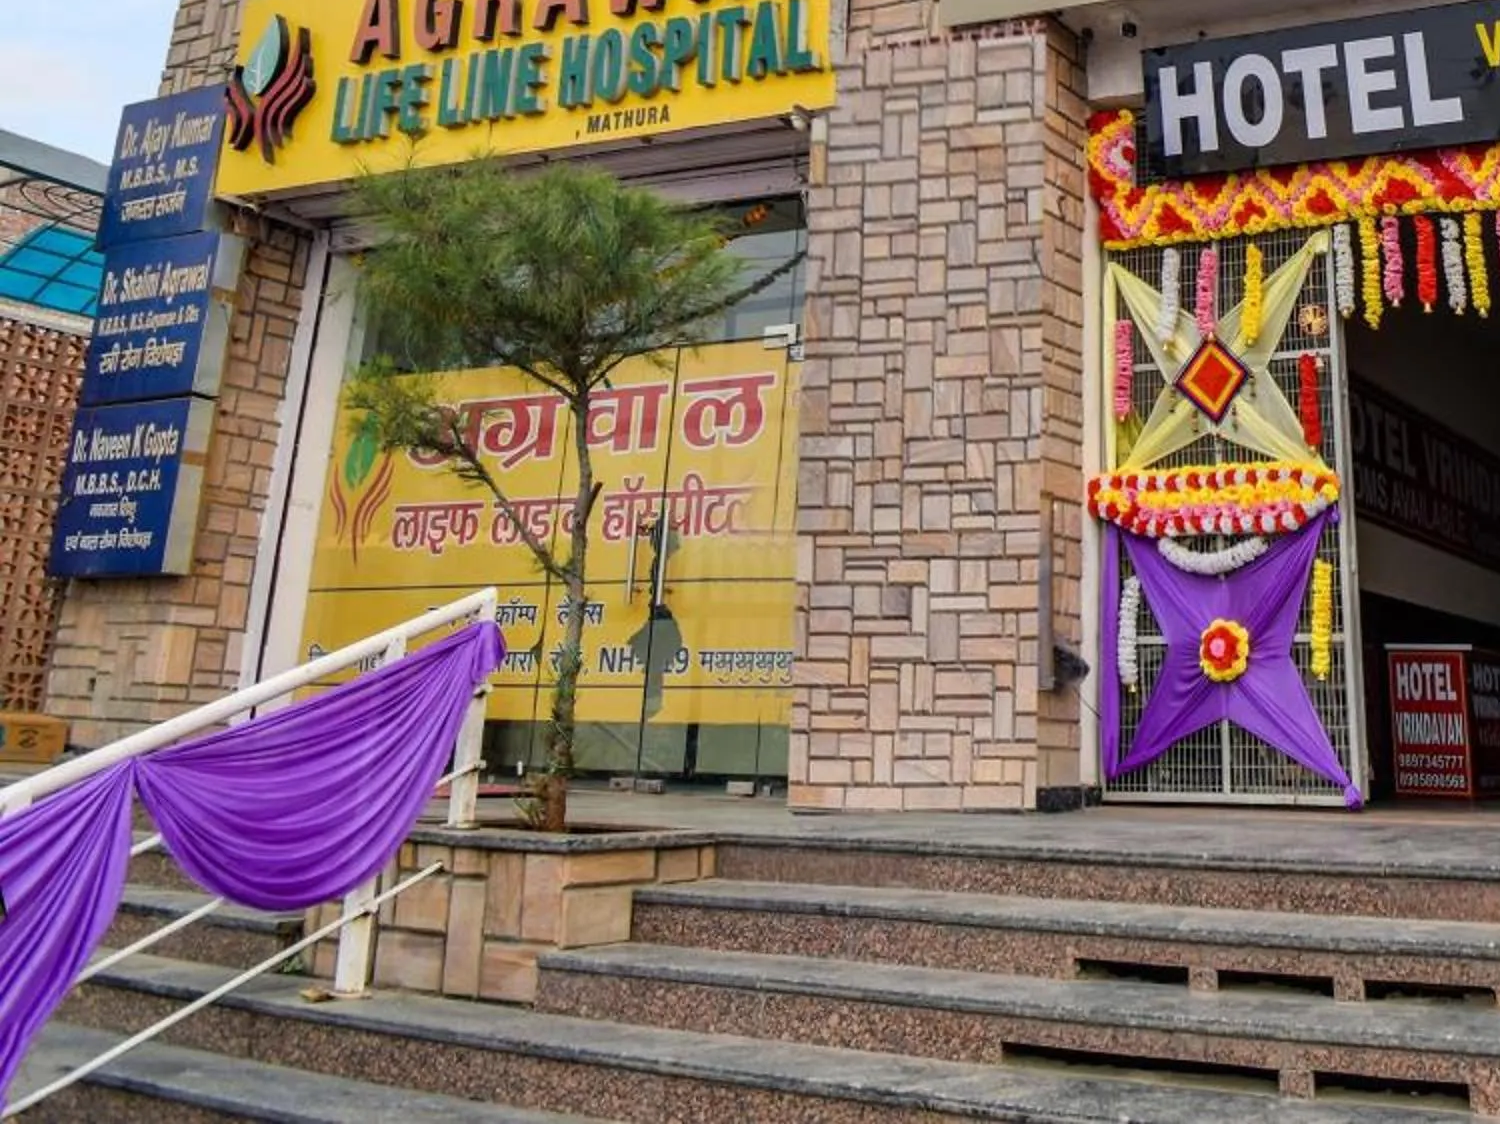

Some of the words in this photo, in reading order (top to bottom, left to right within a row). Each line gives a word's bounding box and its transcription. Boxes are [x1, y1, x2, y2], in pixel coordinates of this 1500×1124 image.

[331, 62, 433, 145] LIFE
[437, 35, 552, 130] LINE
[1158, 31, 1463, 157] HOTEL
[140, 118, 171, 163] Ajay
[171, 112, 216, 148] Kumar
[587, 104, 671, 134] MATHURA
[89, 428, 132, 462] Naveen
[132, 424, 145, 457] K
[144, 423, 179, 464] Gupta
[392, 500, 486, 554] लाइफ
[1396, 662, 1457, 701] HOTEL
[1396, 712, 1464, 745] VRINDAVAN
